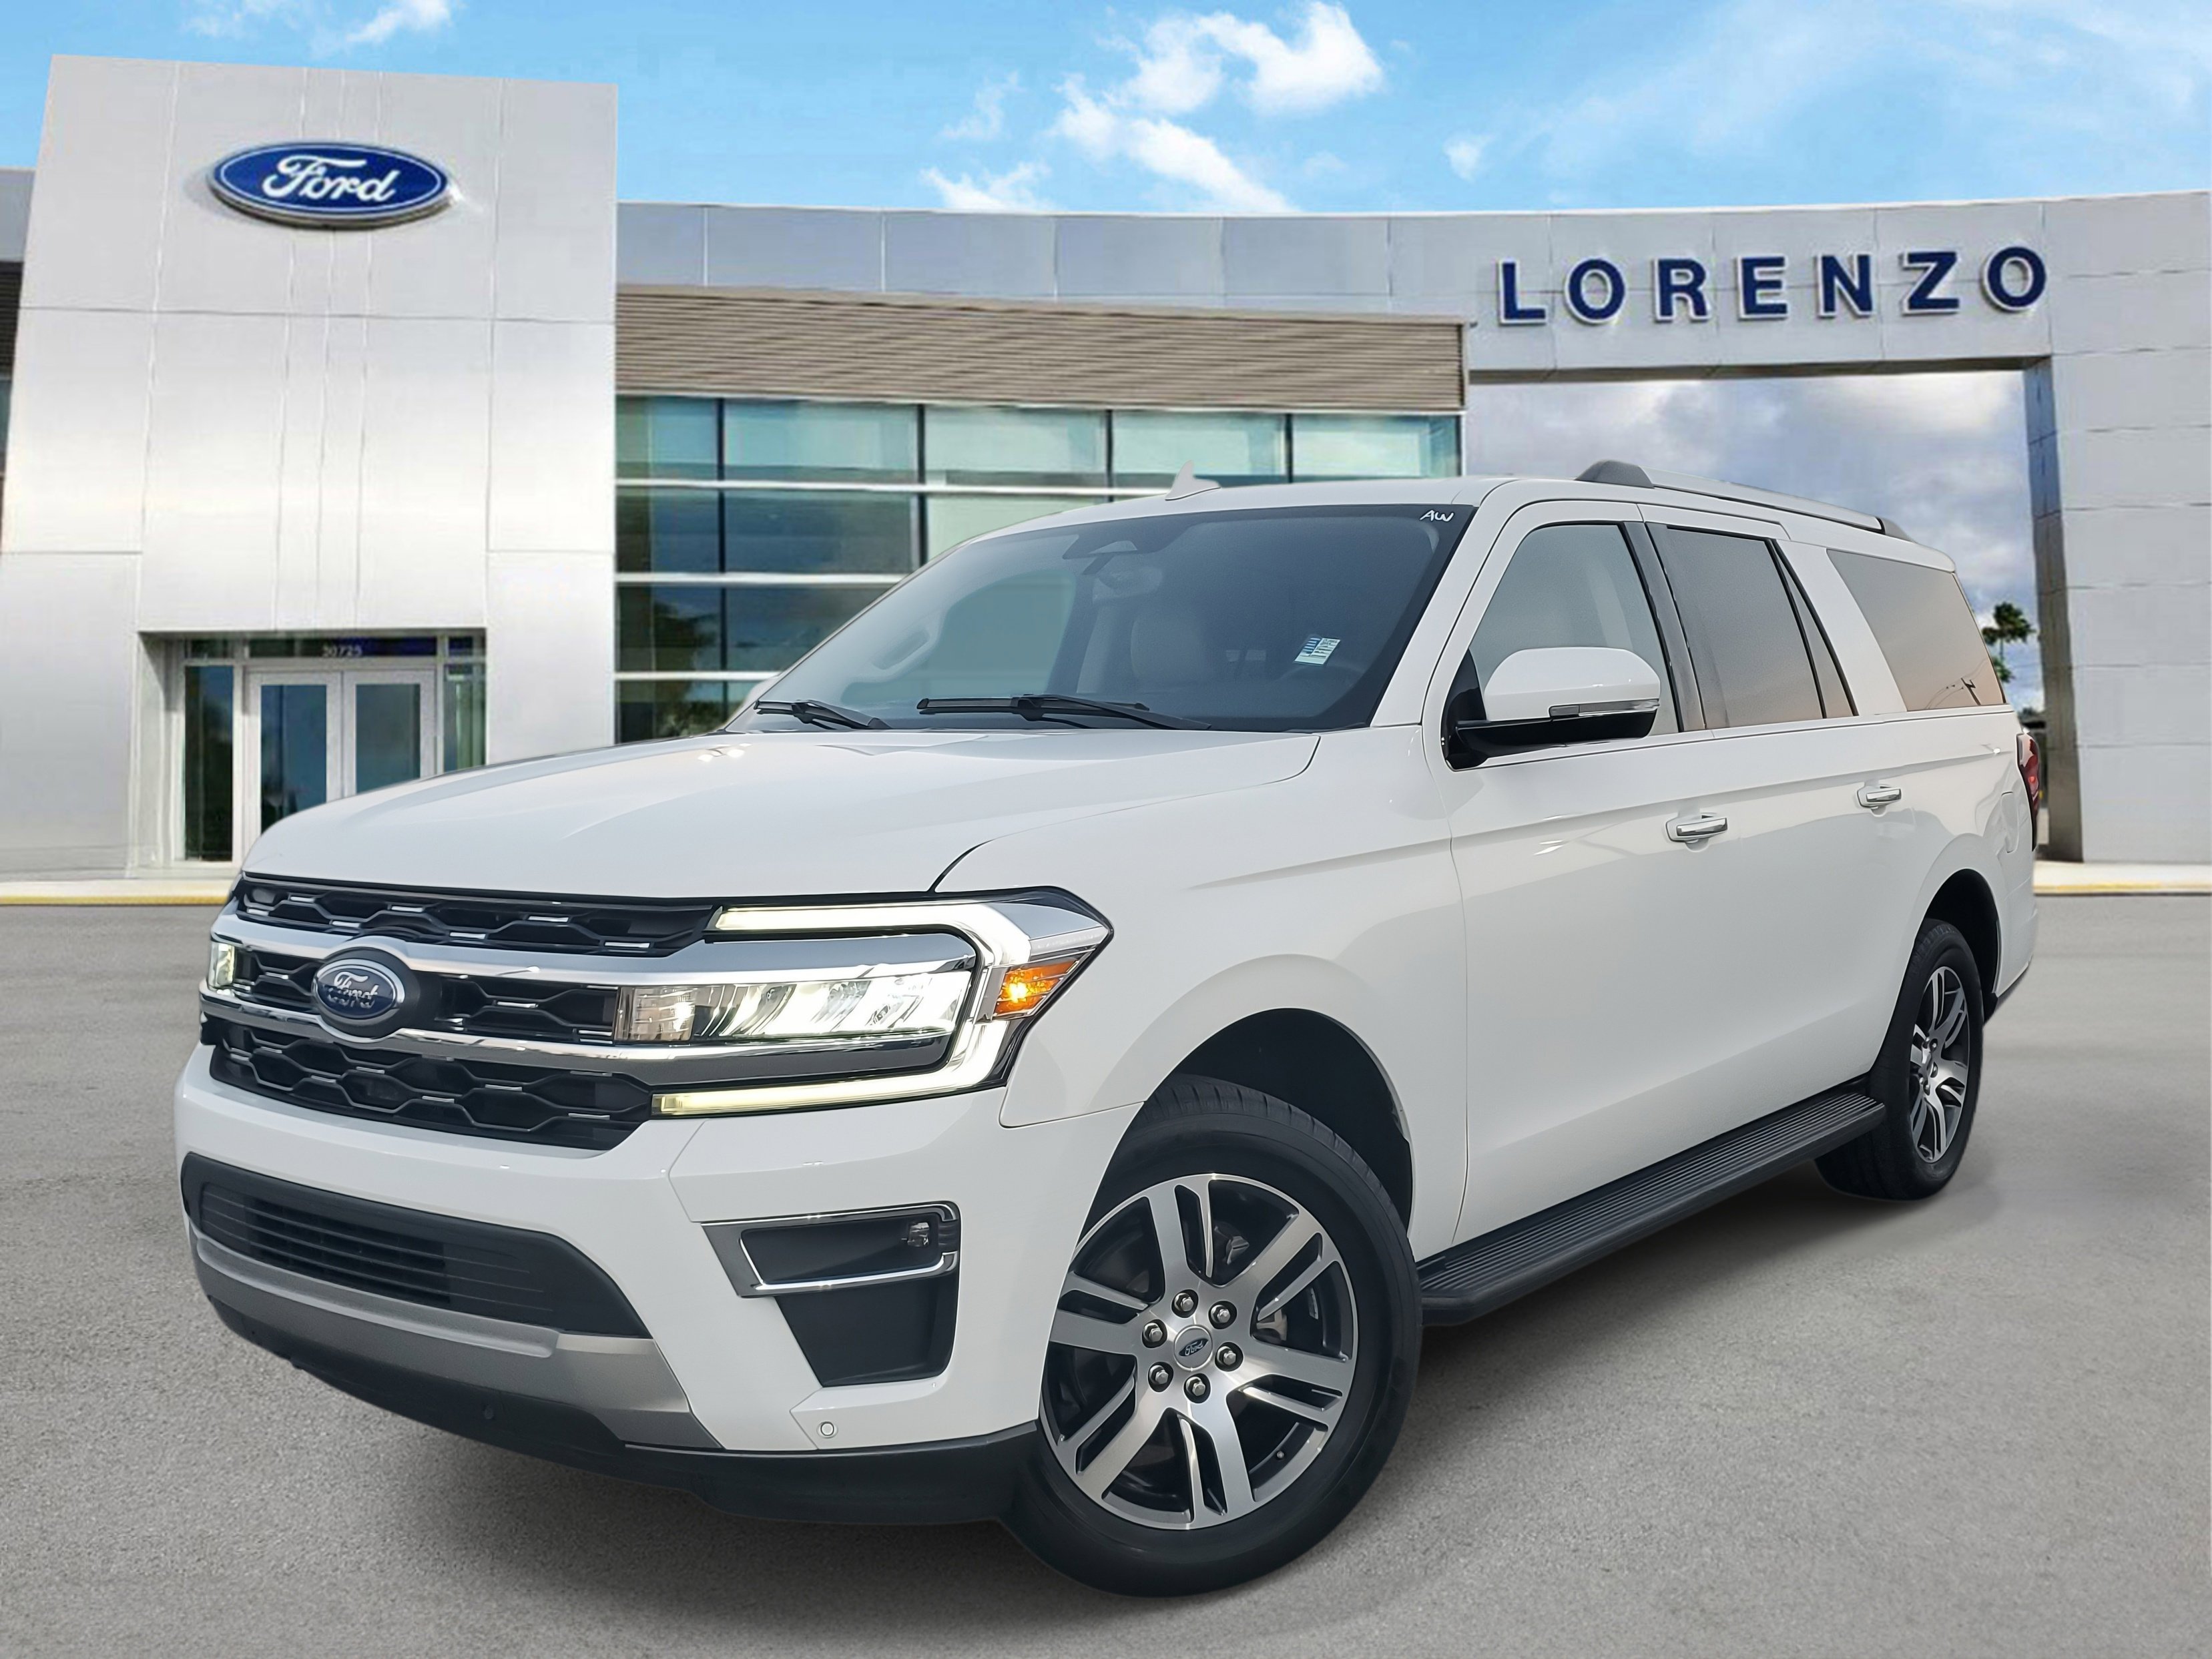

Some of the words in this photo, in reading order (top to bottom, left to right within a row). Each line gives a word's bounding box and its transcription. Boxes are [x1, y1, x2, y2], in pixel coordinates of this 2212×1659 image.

[262, 154, 400, 202] Ford
[1496, 244, 2048, 326] LORENZO
[1185, 1340, 1203, 1356] Ford
